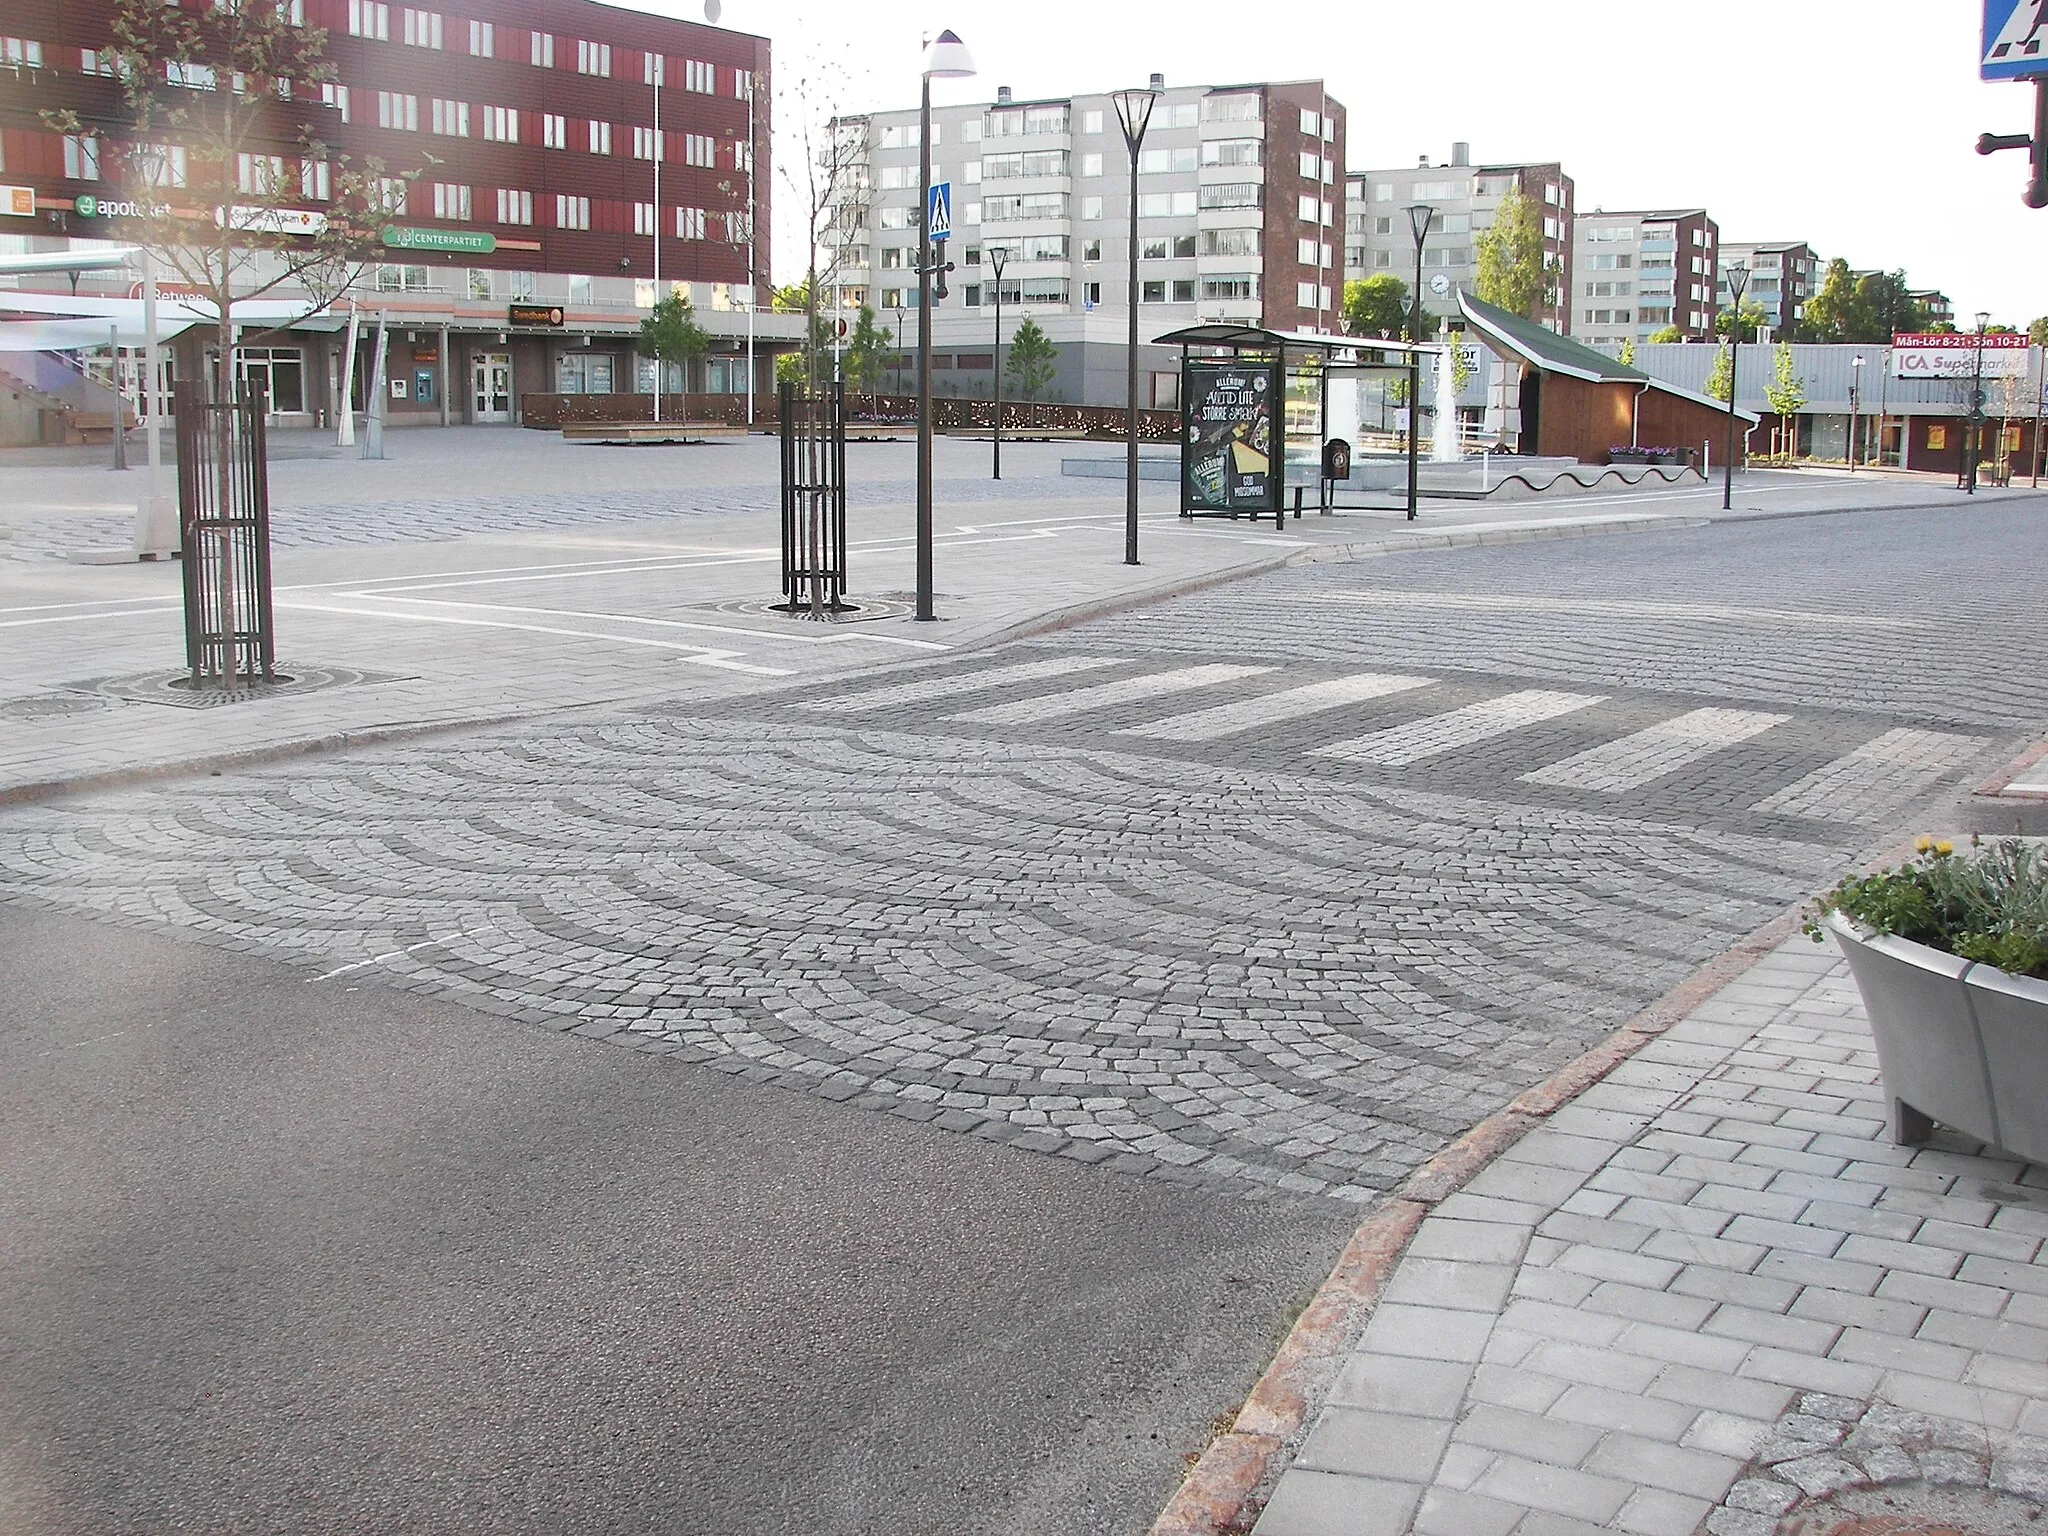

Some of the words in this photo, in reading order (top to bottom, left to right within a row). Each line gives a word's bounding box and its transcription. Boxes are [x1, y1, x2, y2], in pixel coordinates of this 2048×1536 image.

[97, 200, 172, 219] apoteet
[415, 233, 483, 247] CENTERPARTIET
[155, 288, 210, 301] Betwee
[1896, 336, 1941, 347] Mån-Lör
[1973, 337, 1994, 347] Sön
[1997, 337, 2027, 347] 10-21
[1899, 354, 1929, 371] ICA
[1238, 391, 1254, 405] LITE
